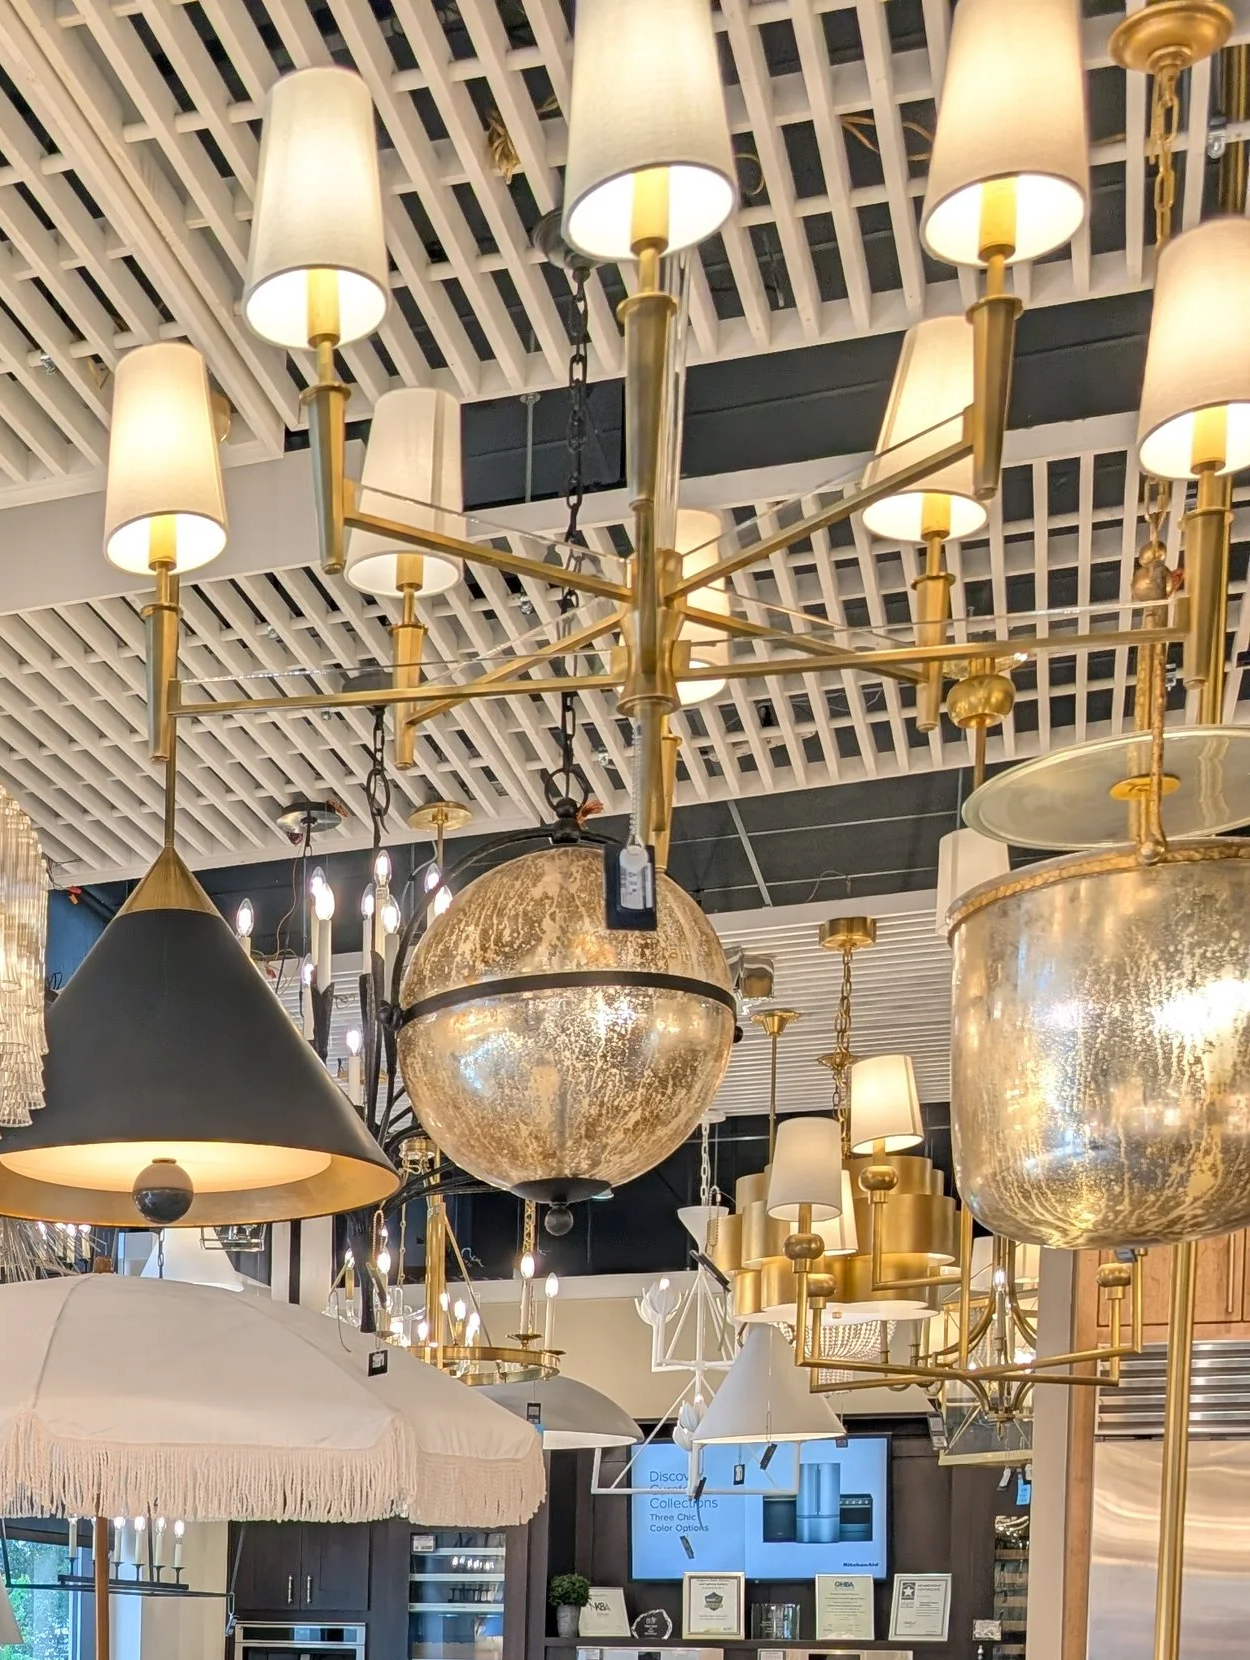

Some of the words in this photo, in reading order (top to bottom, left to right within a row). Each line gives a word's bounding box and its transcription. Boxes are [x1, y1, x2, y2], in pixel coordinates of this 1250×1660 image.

[649, 1497, 719, 1509] Collections
[649, 1513, 674, 1521] Three
[677, 1513, 697, 1521] Chic
[649, 1524, 673, 1532] Color
[675, 1524, 710, 1533] Options
